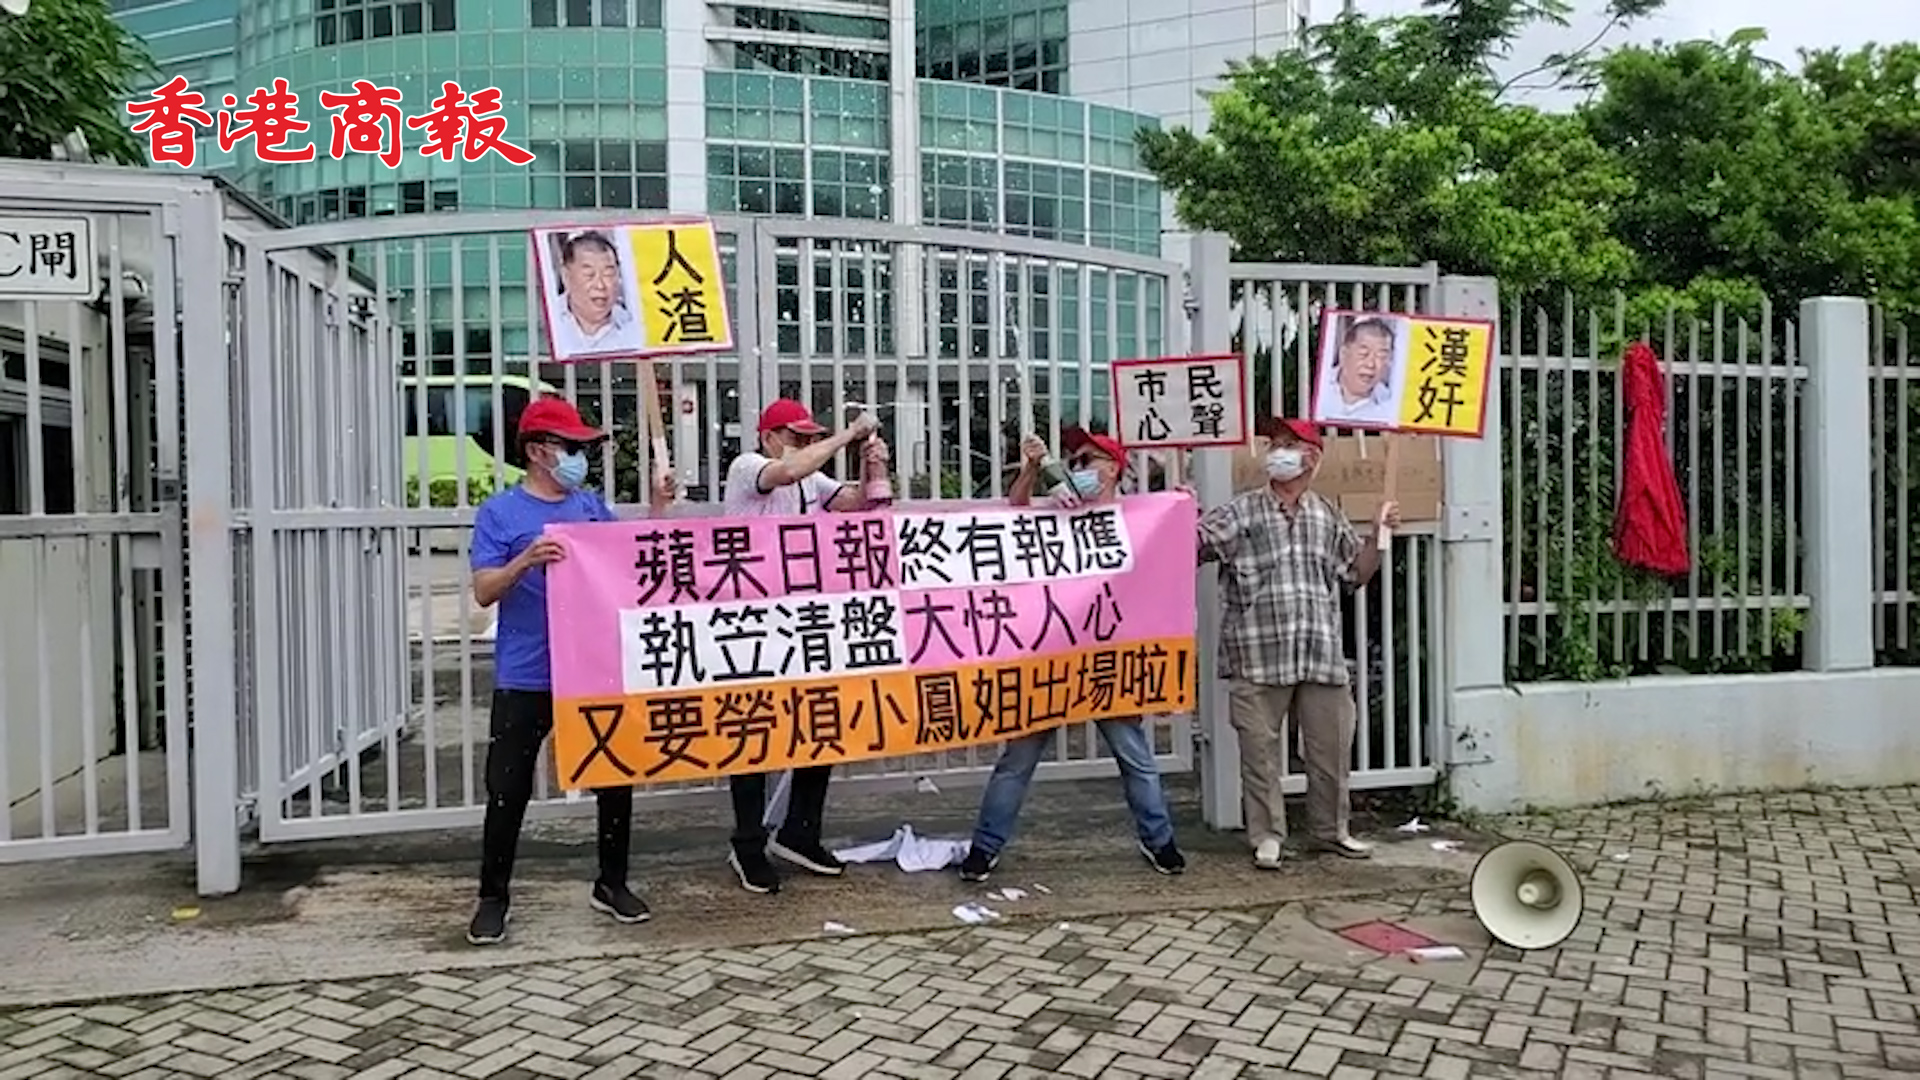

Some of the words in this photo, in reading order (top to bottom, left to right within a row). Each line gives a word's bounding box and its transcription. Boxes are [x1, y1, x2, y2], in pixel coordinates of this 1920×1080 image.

[653, 230, 713, 341] 人渣
[1413, 327, 1470, 426] 漢奸
[635, 509, 1127, 605] 蘋果日報終有報應
[639, 582, 1122, 686] 執笠清盤大快人心
